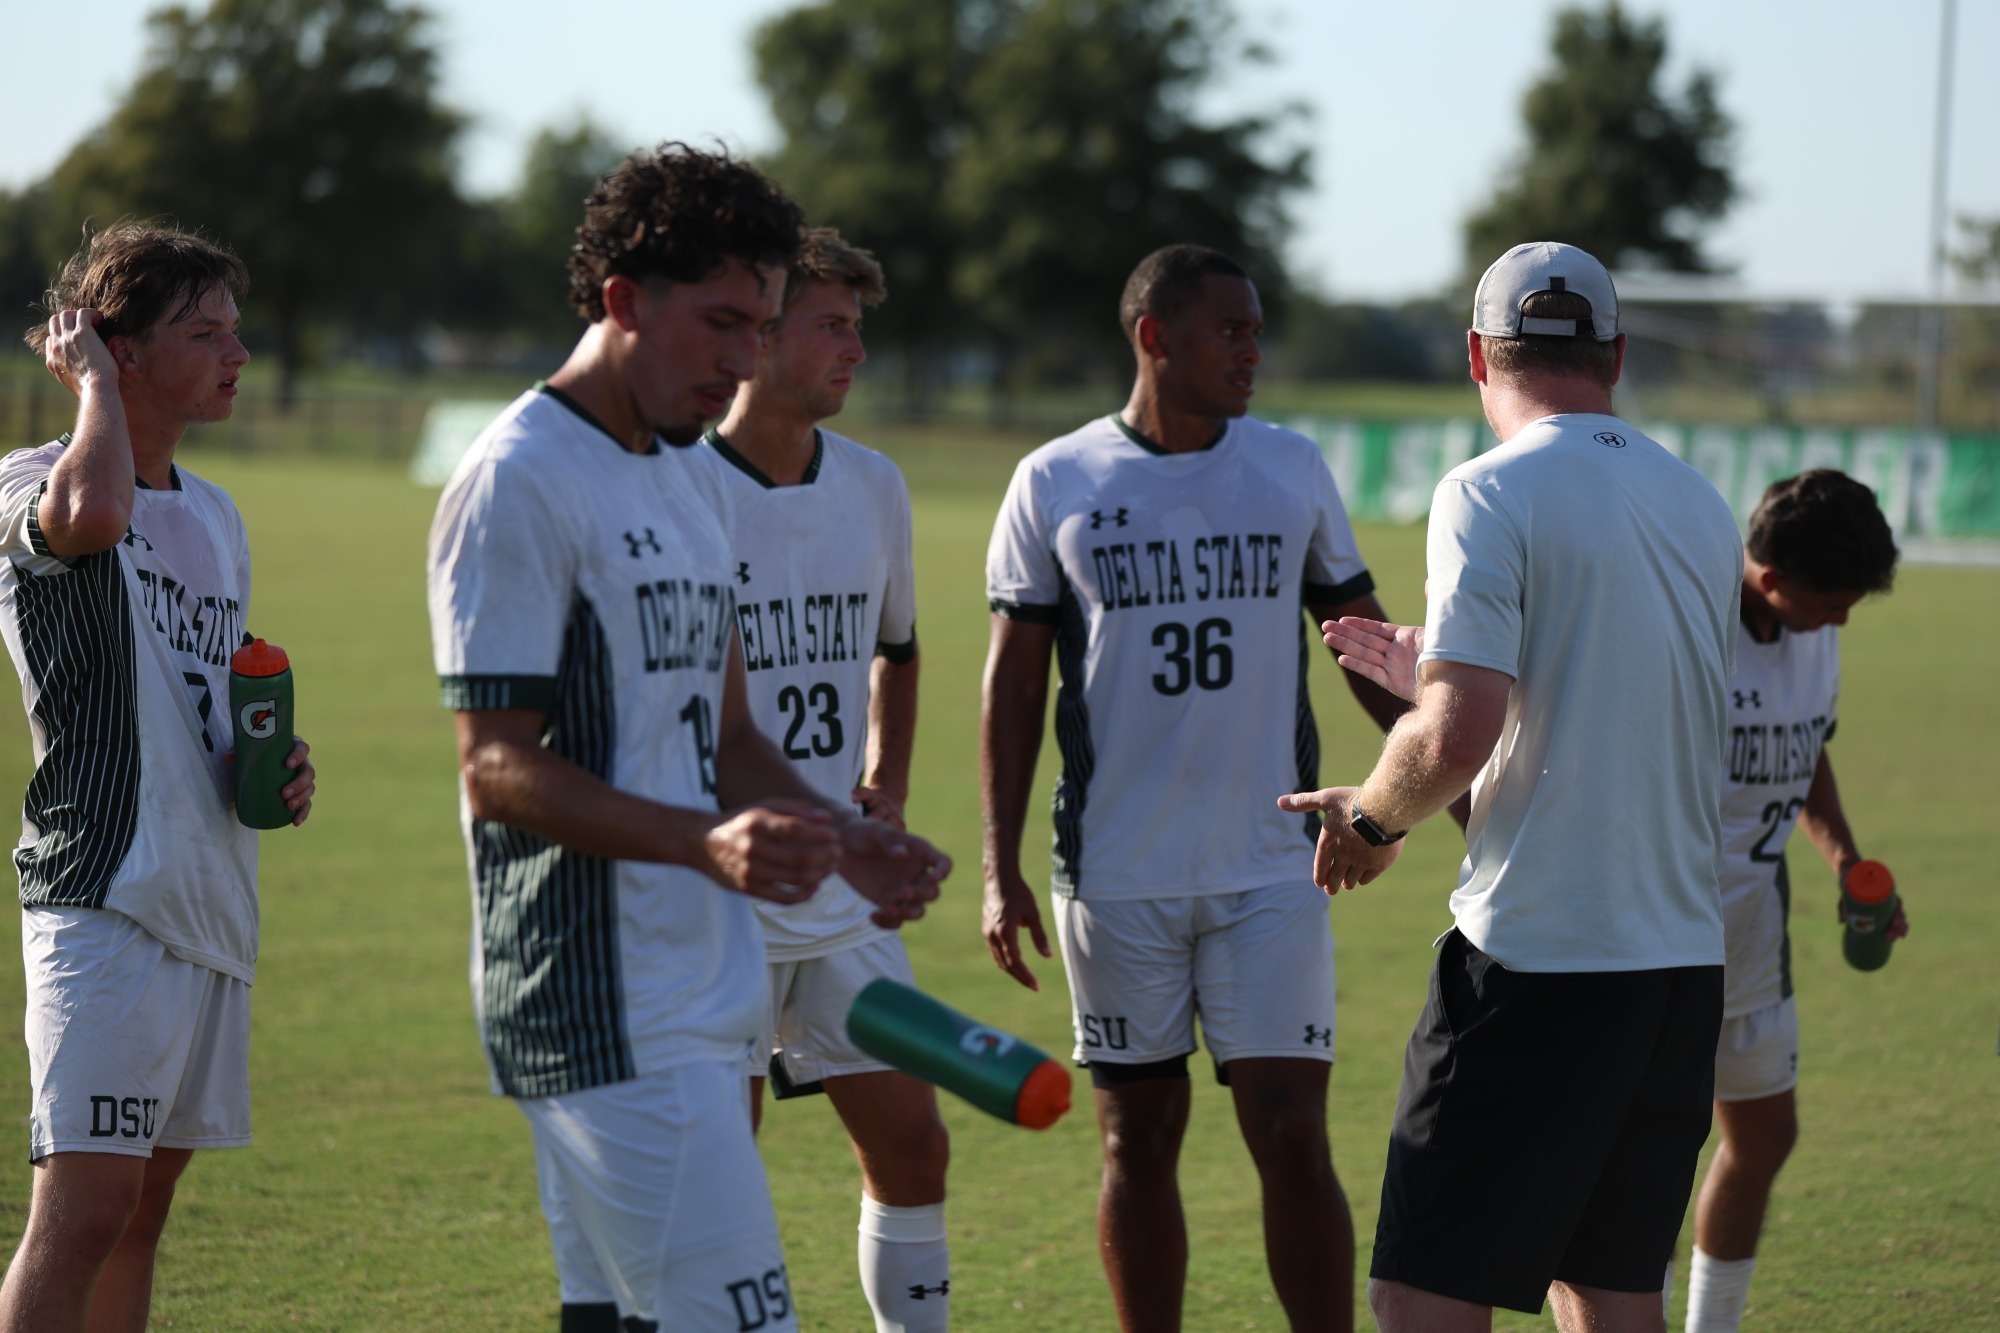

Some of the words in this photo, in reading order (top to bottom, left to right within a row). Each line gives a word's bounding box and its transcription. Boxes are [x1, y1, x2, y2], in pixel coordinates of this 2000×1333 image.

[1092, 540, 1186, 612] DELTA
[1194, 534, 1282, 600] STATE
[192, 596, 241, 667] STAT
[737, 597, 799, 672] ELTA
[1151, 617, 1234, 697] 36
[240, 698, 277, 740] G
[777, 682, 844, 761] 23
[1079, 1013, 1128, 1050] SU
[90, 1095, 158, 1140] DSU
[725, 1262, 789, 1332] DS
